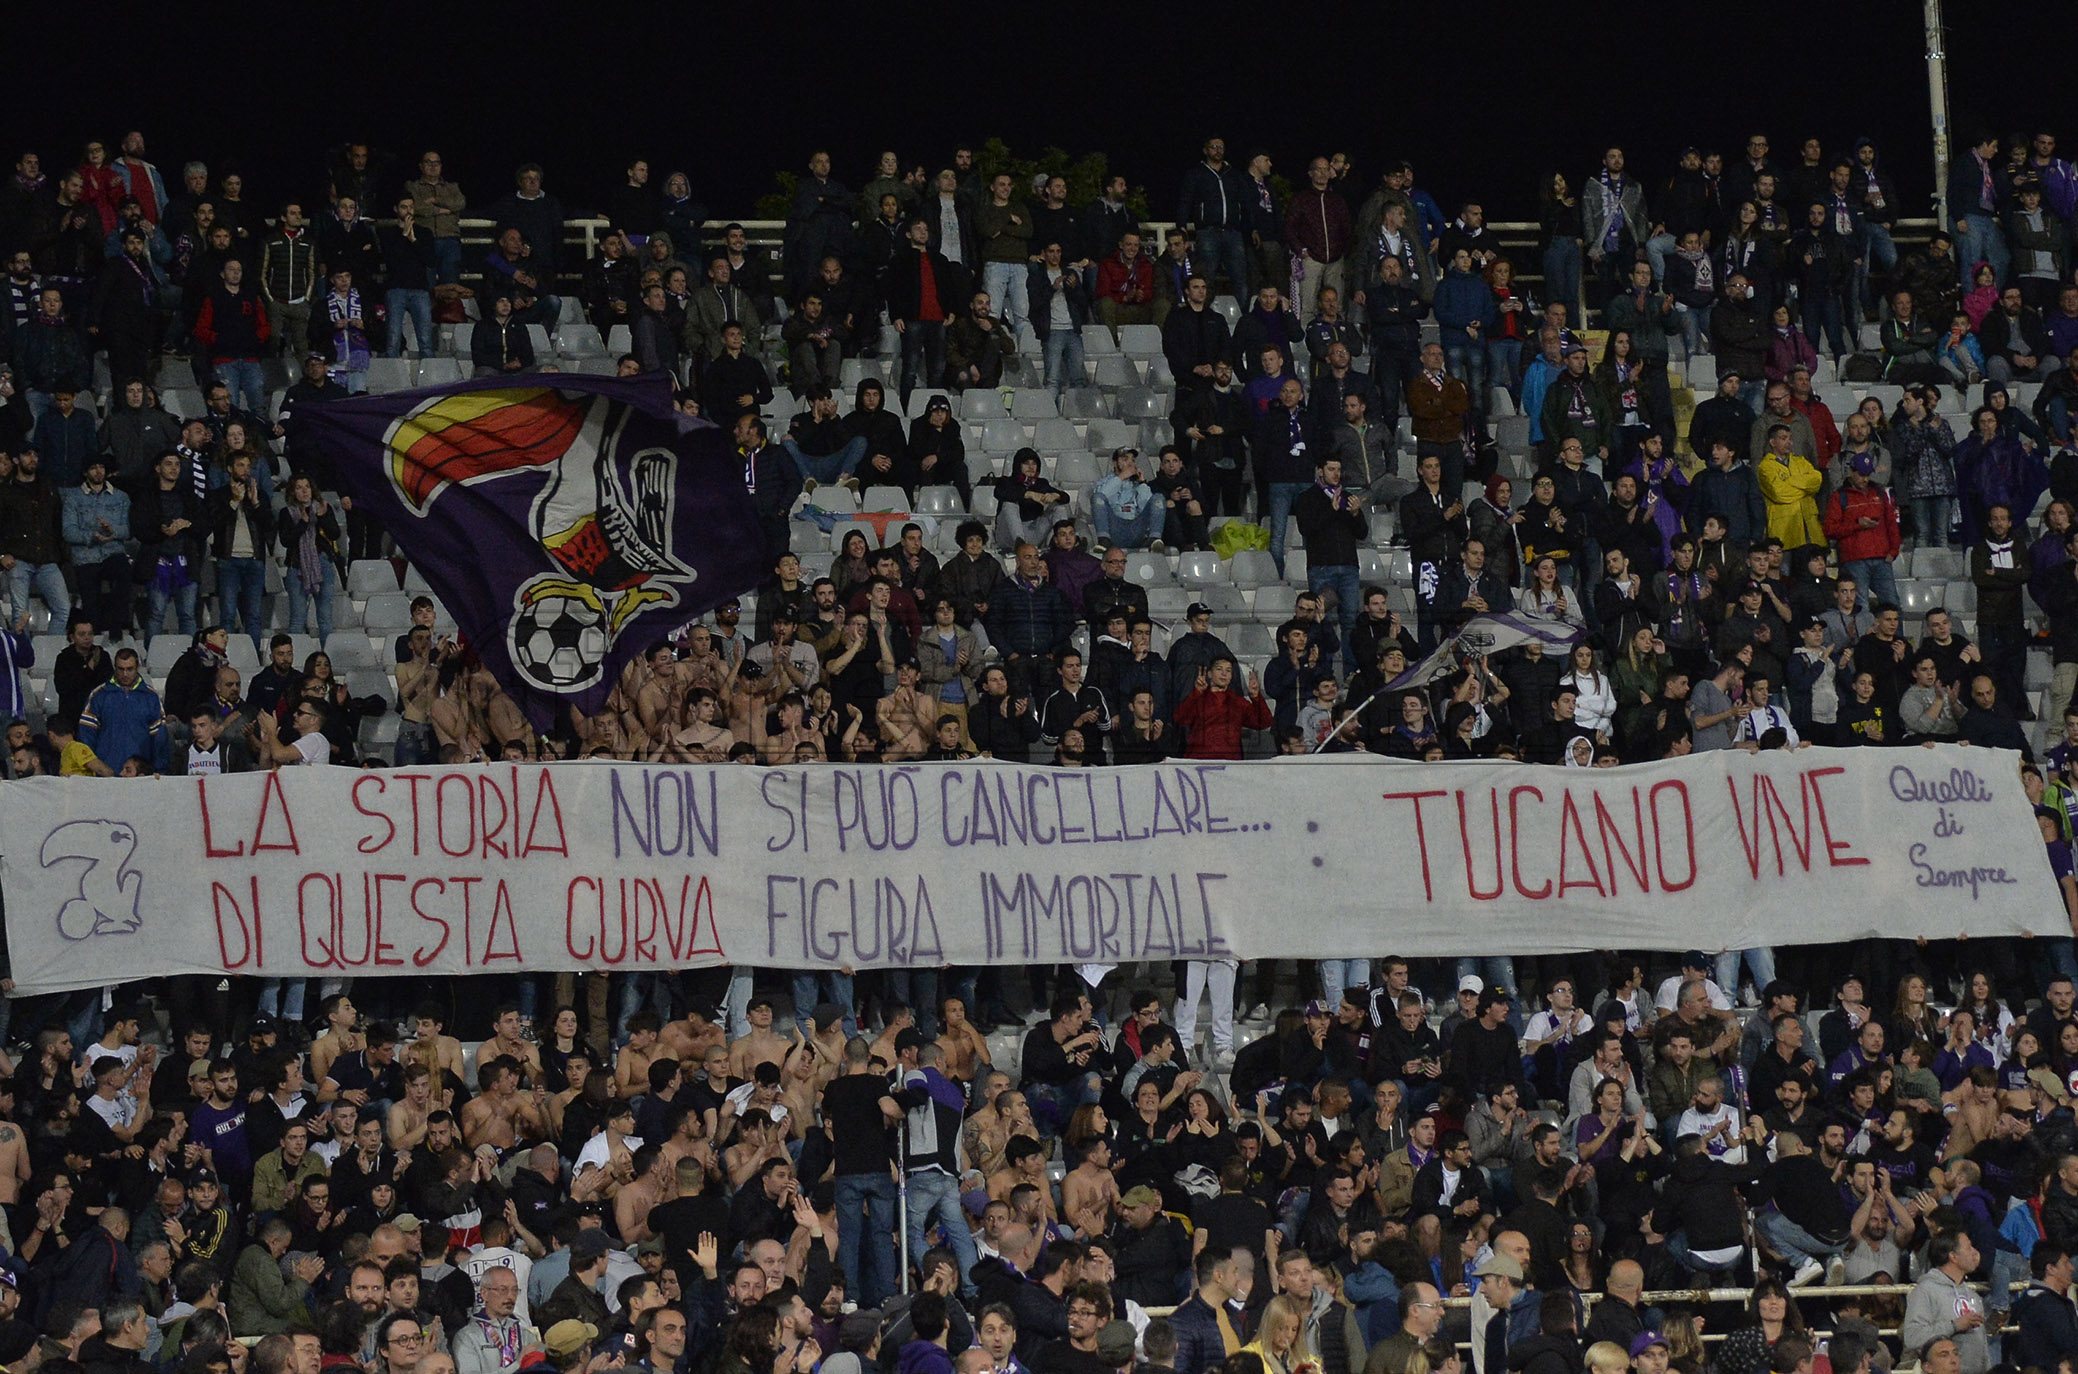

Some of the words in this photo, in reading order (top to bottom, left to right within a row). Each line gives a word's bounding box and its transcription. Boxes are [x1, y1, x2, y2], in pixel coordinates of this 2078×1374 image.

[198, 771, 300, 858] LA
[352, 767, 569, 859] STORIA
[611, 768, 720, 858] NON
[761, 771, 809, 853] SI
[1889, 764, 1993, 804] Quelli
[1383, 779, 1697, 901] TUCANO
[1727, 767, 1870, 880] VIVE
[1933, 808, 1964, 838] di
[1909, 842, 2017, 900] Sempre
[212, 876, 263, 970] DI
[298, 872, 523, 970] QUESTA
[566, 875, 725, 965] CURVA
[767, 874, 943, 962] FIGURA
[981, 872, 1228, 961] IMMORTALE
